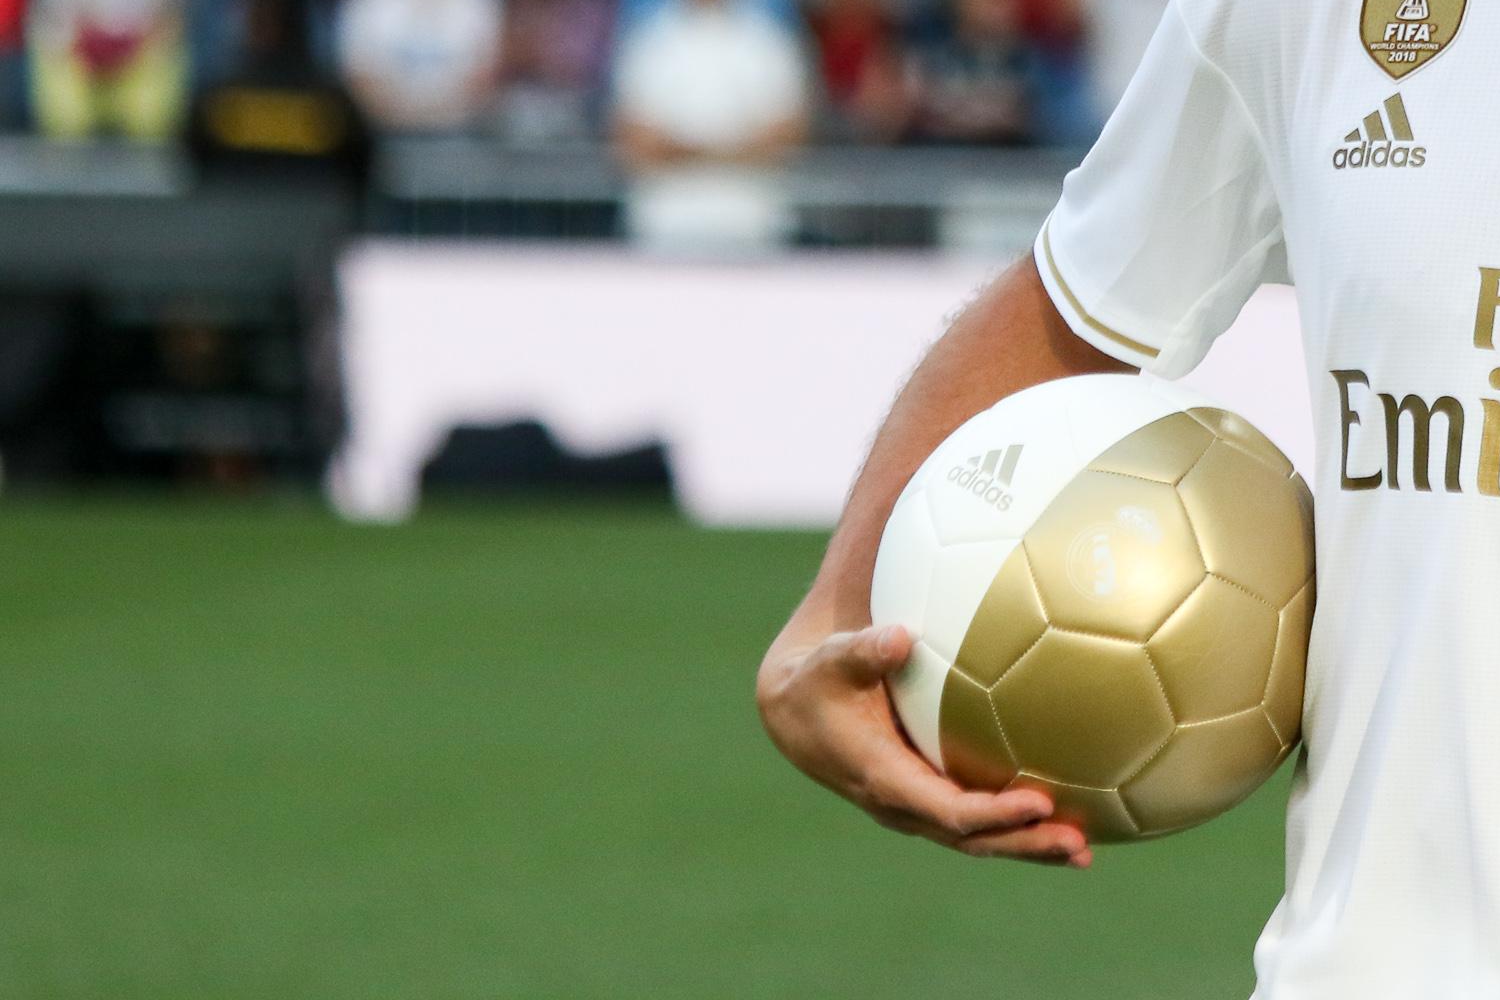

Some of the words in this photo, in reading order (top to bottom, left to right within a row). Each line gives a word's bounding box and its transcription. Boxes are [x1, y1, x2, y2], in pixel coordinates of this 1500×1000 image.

[1383, 23, 1431, 42] FIFA
[1370, 42, 1395, 51] WORLD
[1396, 42, 1440, 51] CHAMPIONS
[1387, 51, 1417, 63] 2018
[1332, 140, 1427, 170] adidas
[946, 464, 1013, 511] adidas
